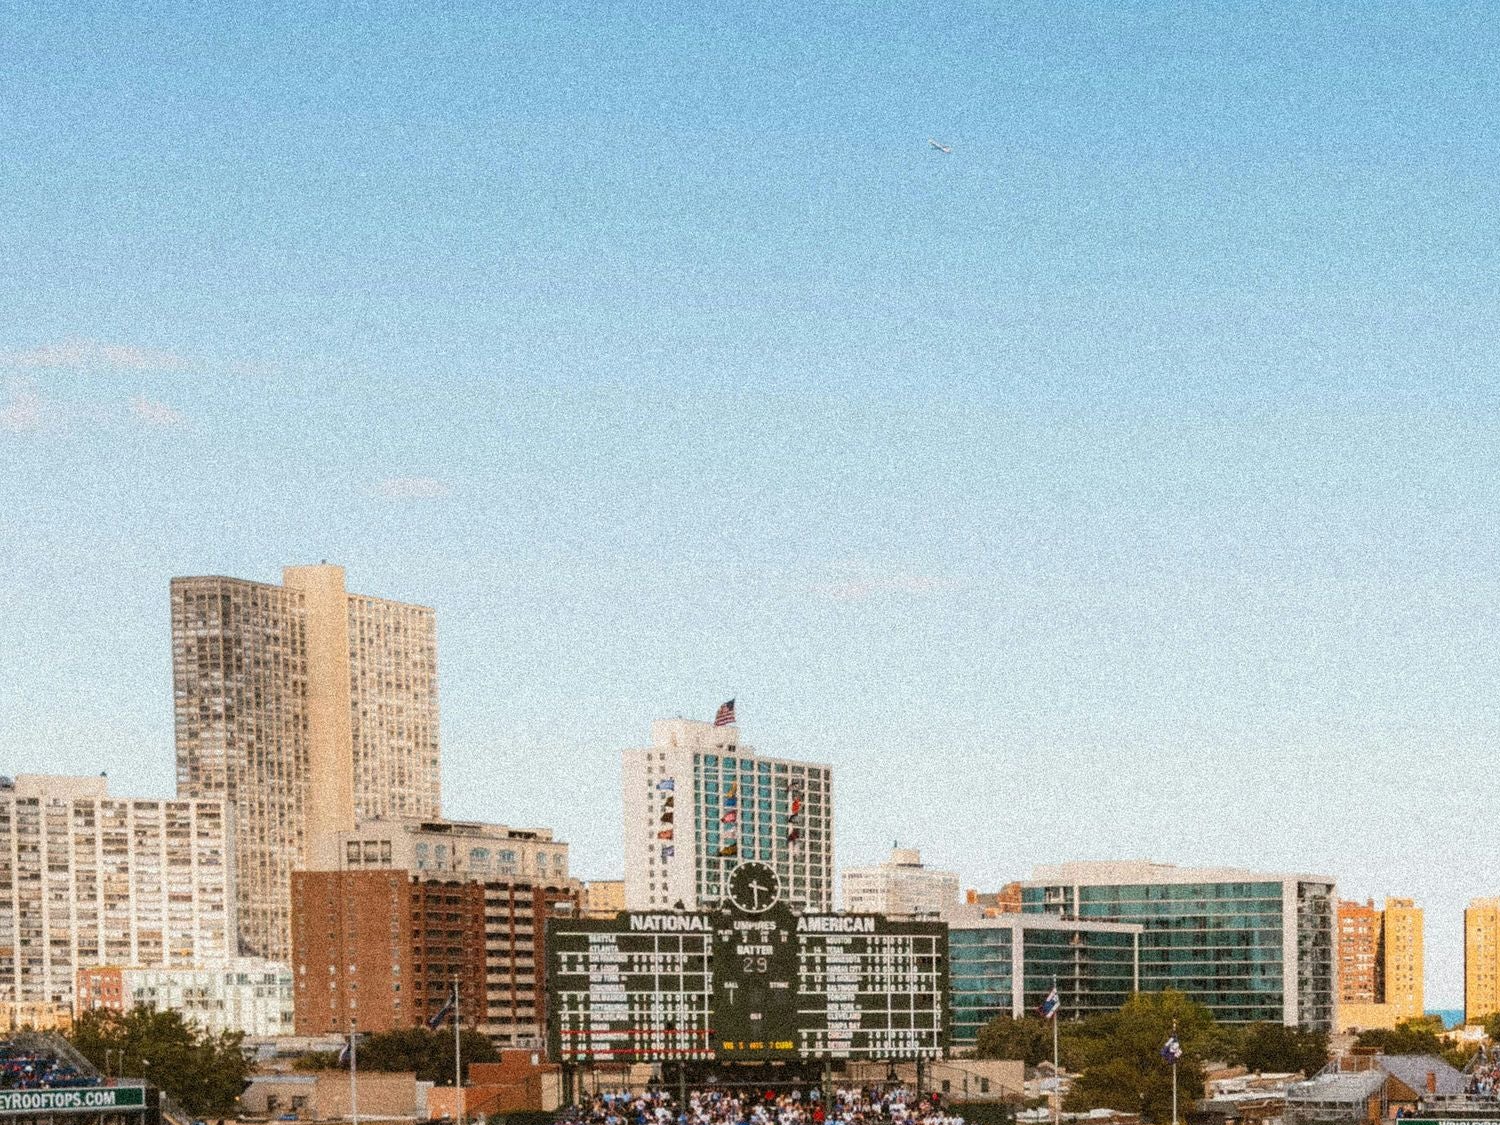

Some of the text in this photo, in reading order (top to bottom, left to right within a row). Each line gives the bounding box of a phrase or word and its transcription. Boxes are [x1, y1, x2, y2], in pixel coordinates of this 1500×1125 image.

[630, 915, 713, 931] NATIONAL
[733, 921, 777, 930] UMPIRES
[796, 917, 875, 932] AMERICAN
[737, 945, 774, 955] BATTER
[743, 957, 768, 973] 29
